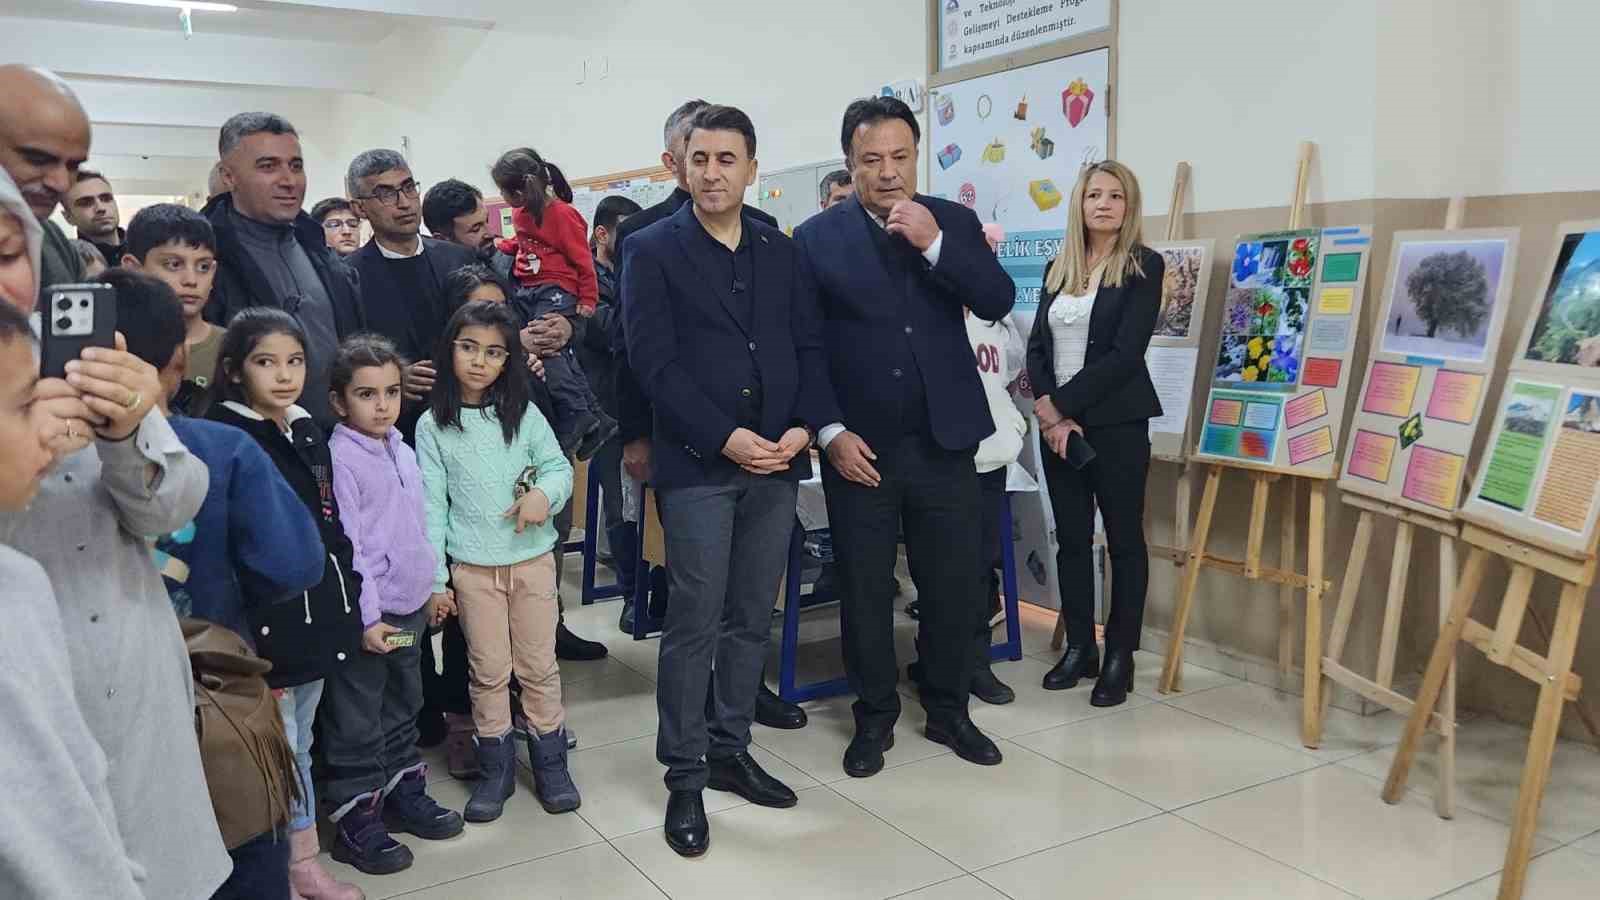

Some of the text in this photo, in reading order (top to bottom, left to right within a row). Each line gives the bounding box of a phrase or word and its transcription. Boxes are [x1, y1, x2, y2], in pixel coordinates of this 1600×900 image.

[963, 10, 973, 18] ve
[963, 19, 1000, 37] Gelişmeyi
[1006, 4, 1053, 25] Destekleme
[963, 17, 1077, 56] kapsamında düzenlenmiştir.
